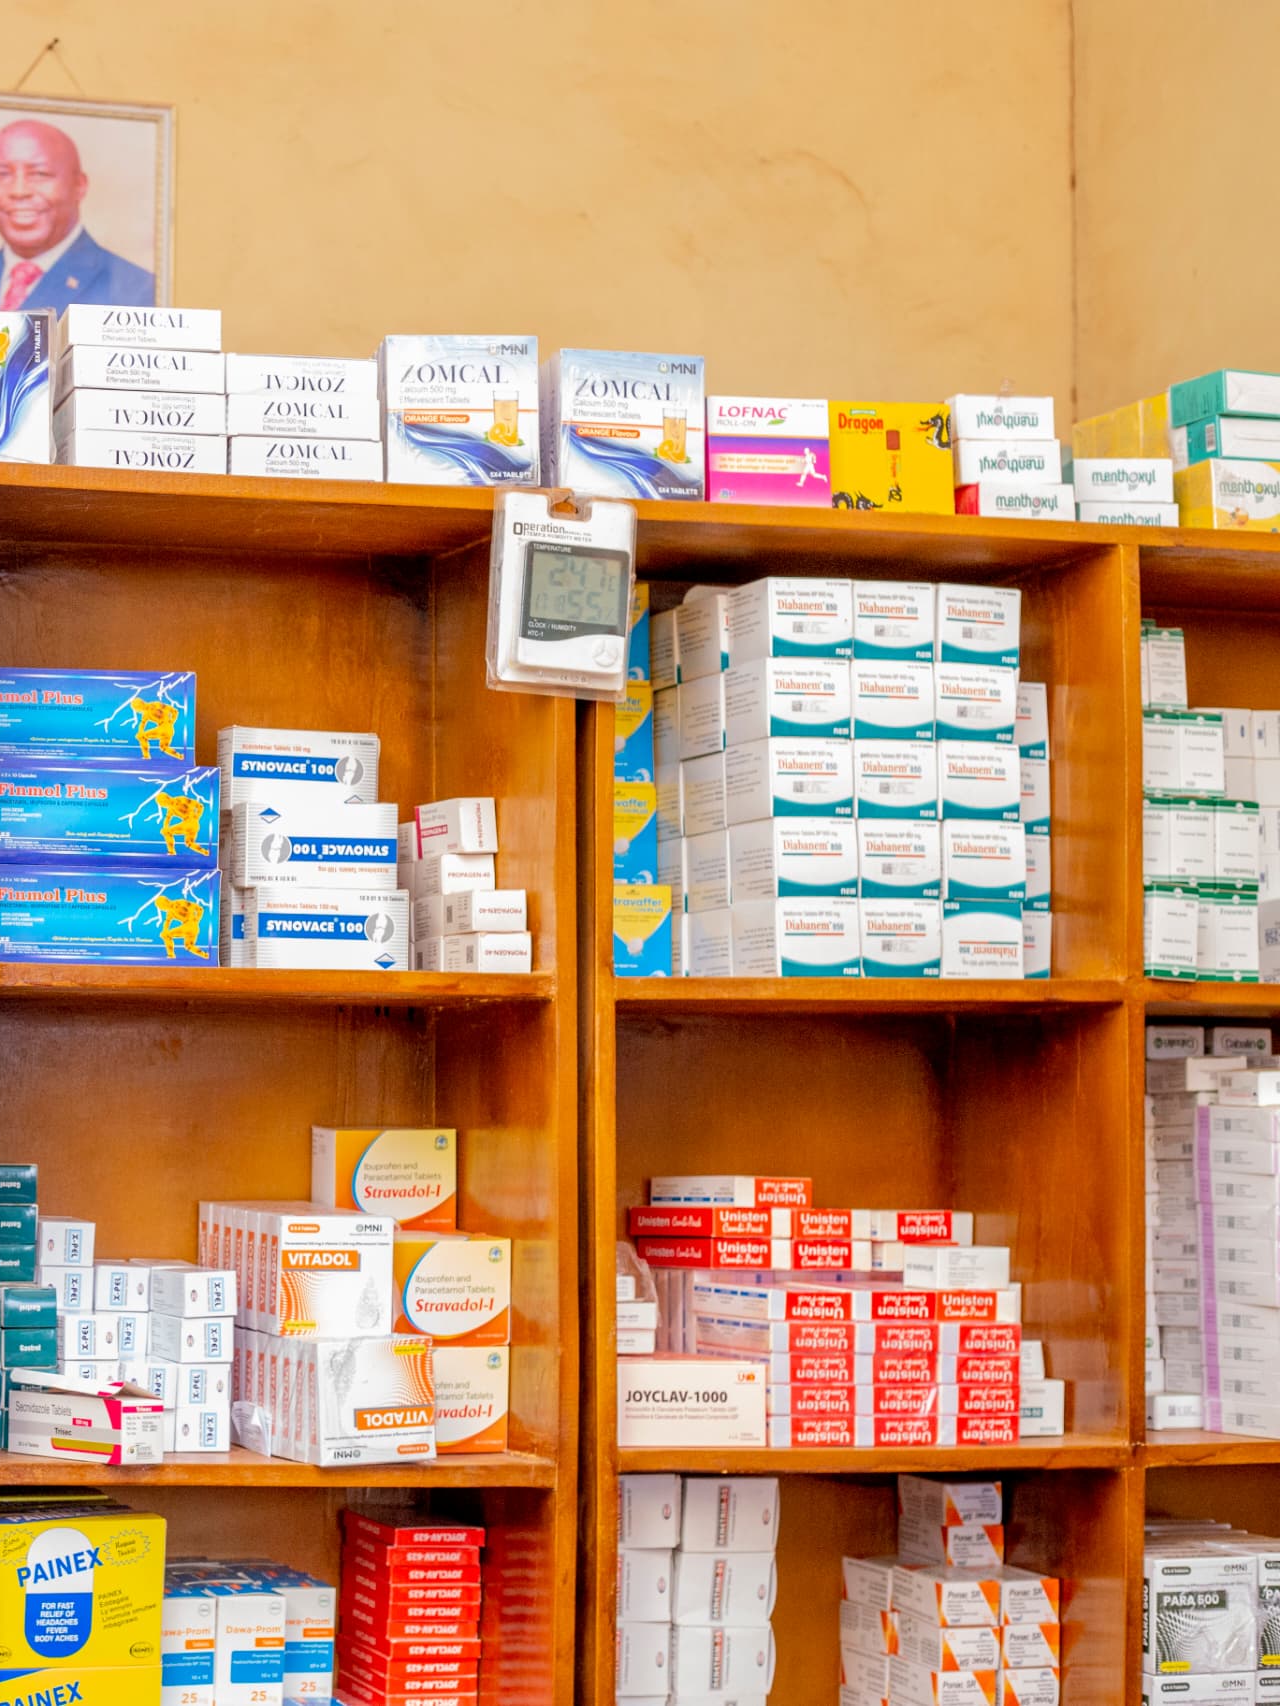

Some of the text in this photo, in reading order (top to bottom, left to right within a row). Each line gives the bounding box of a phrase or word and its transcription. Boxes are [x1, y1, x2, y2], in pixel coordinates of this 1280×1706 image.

[103, 311, 189, 328] ZOMCAL
[107, 352, 193, 371] ZOMCAL
[400, 364, 509, 383] ZOMCAL
[261, 374, 344, 392] ZOMCAL
[575, 378, 678, 401] ZOMCAL
[718, 407, 788, 419] LOFNAC
[717, 419, 756, 427] ROLL-ON
[838, 413, 883, 434] Dragon
[513, 522, 565, 536] Operation
[533, 543, 572, 553] TEMPERATURE
[777, 599, 823, 613] Diabanem
[528, 621, 576, 632] CLOCK HUMIDITY
[774, 679, 821, 692] Diabanem
[241, 760, 334, 776] SYNOVACE 100
[65, 785, 108, 799] Plus
[65, 889, 107, 904] Plus
[613, 897, 663, 909] travaffer
[266, 920, 363, 934] SYNOVACE 100
[364, 1162, 418, 1172] Ibuprofen and
[364, 1172, 442, 1181] Paracetamol Tablets
[364, 1185, 441, 1199] Stravadol-I
[720, 1210, 768, 1224] Unisten
[288, 1253, 352, 1267] VITADOL
[415, 1298, 494, 1313] Stravadol-I
[942, 1293, 994, 1307] Unisten
[624, 1390, 728, 1405] JOYCLAV-1000
[51, 1404, 72, 1417] Tablets
[364, 1412, 429, 1427] VITADOL
[54, 1427, 72, 1436] Trisec
[17, 1547, 104, 1587] PAINEX
[1163, 1594, 1219, 1606] PARA 500
[40, 1610, 64, 1618] RELIEF
[36, 1618, 78, 1626] HEADACHES
[225, 1625, 281, 1634] Dawa-Prom
[55, 1634, 78, 1642] ACHES
[250, 1691, 267, 1702] 25
